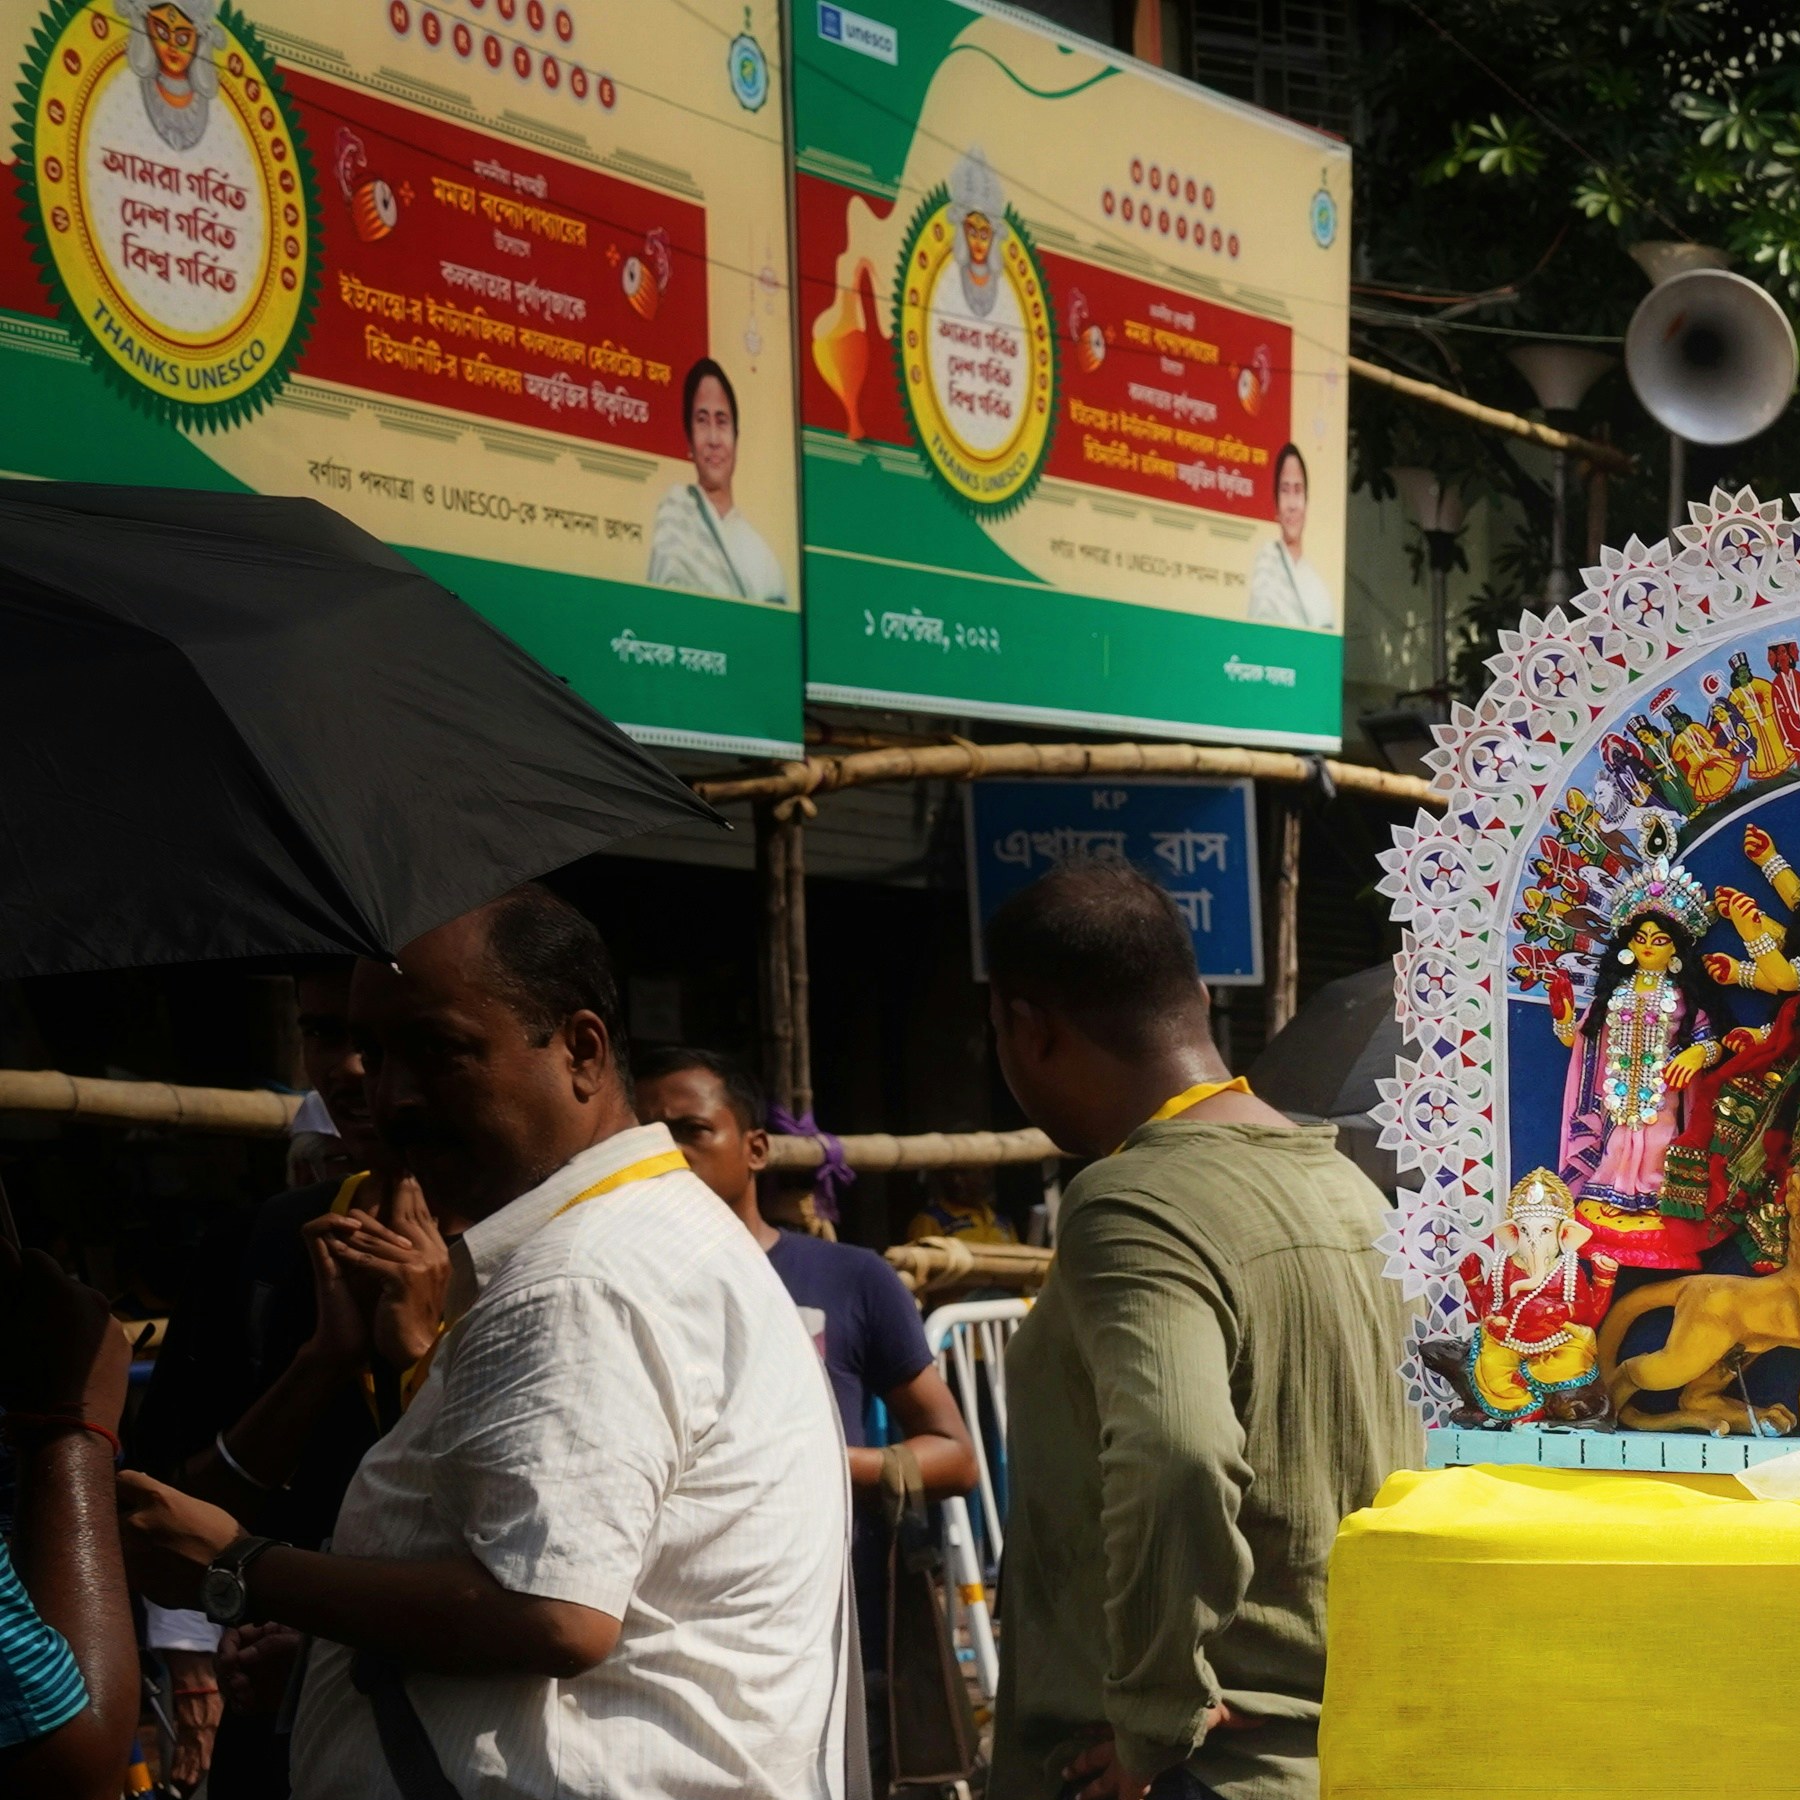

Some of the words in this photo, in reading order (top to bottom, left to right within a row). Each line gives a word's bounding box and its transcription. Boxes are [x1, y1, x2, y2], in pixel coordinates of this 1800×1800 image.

[101, 147, 180, 194] আমরা
[187, 167, 248, 212] গর্বিত
[121, 197, 170, 230] দেশ
[176, 207, 238, 252] গর্বিত
[121, 234, 171, 283] বিশ্ব
[176, 251, 238, 294] গর্বিত
[94, 298, 181, 386] THANKS
[186, 339, 266, 391] UNESCO
[422, 483, 436, 505] ও
[1093, 790, 1128, 810] KP
[1150, 829, 1228, 875] বাস
